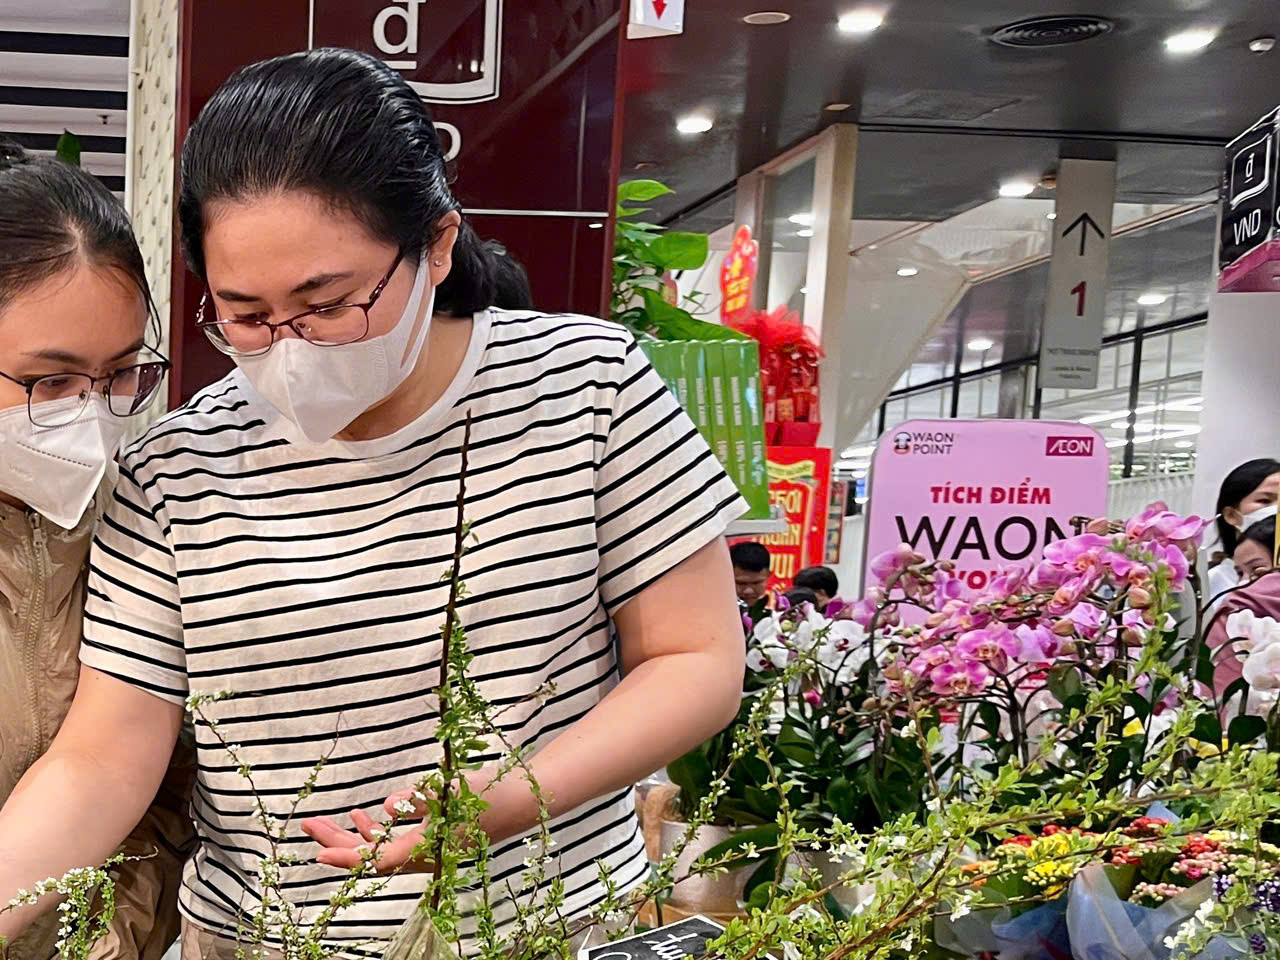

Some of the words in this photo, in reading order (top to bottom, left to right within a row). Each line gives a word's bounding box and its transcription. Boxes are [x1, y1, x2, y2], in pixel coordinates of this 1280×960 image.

[1233, 209, 1261, 246] VND
[1070, 280, 1087, 317] 1
[913, 432, 954, 443] WAON
[913, 443, 953, 455] POINT
[930, 481, 983, 504] TÍCH
[990, 477, 1051, 504] ĐIỂM
